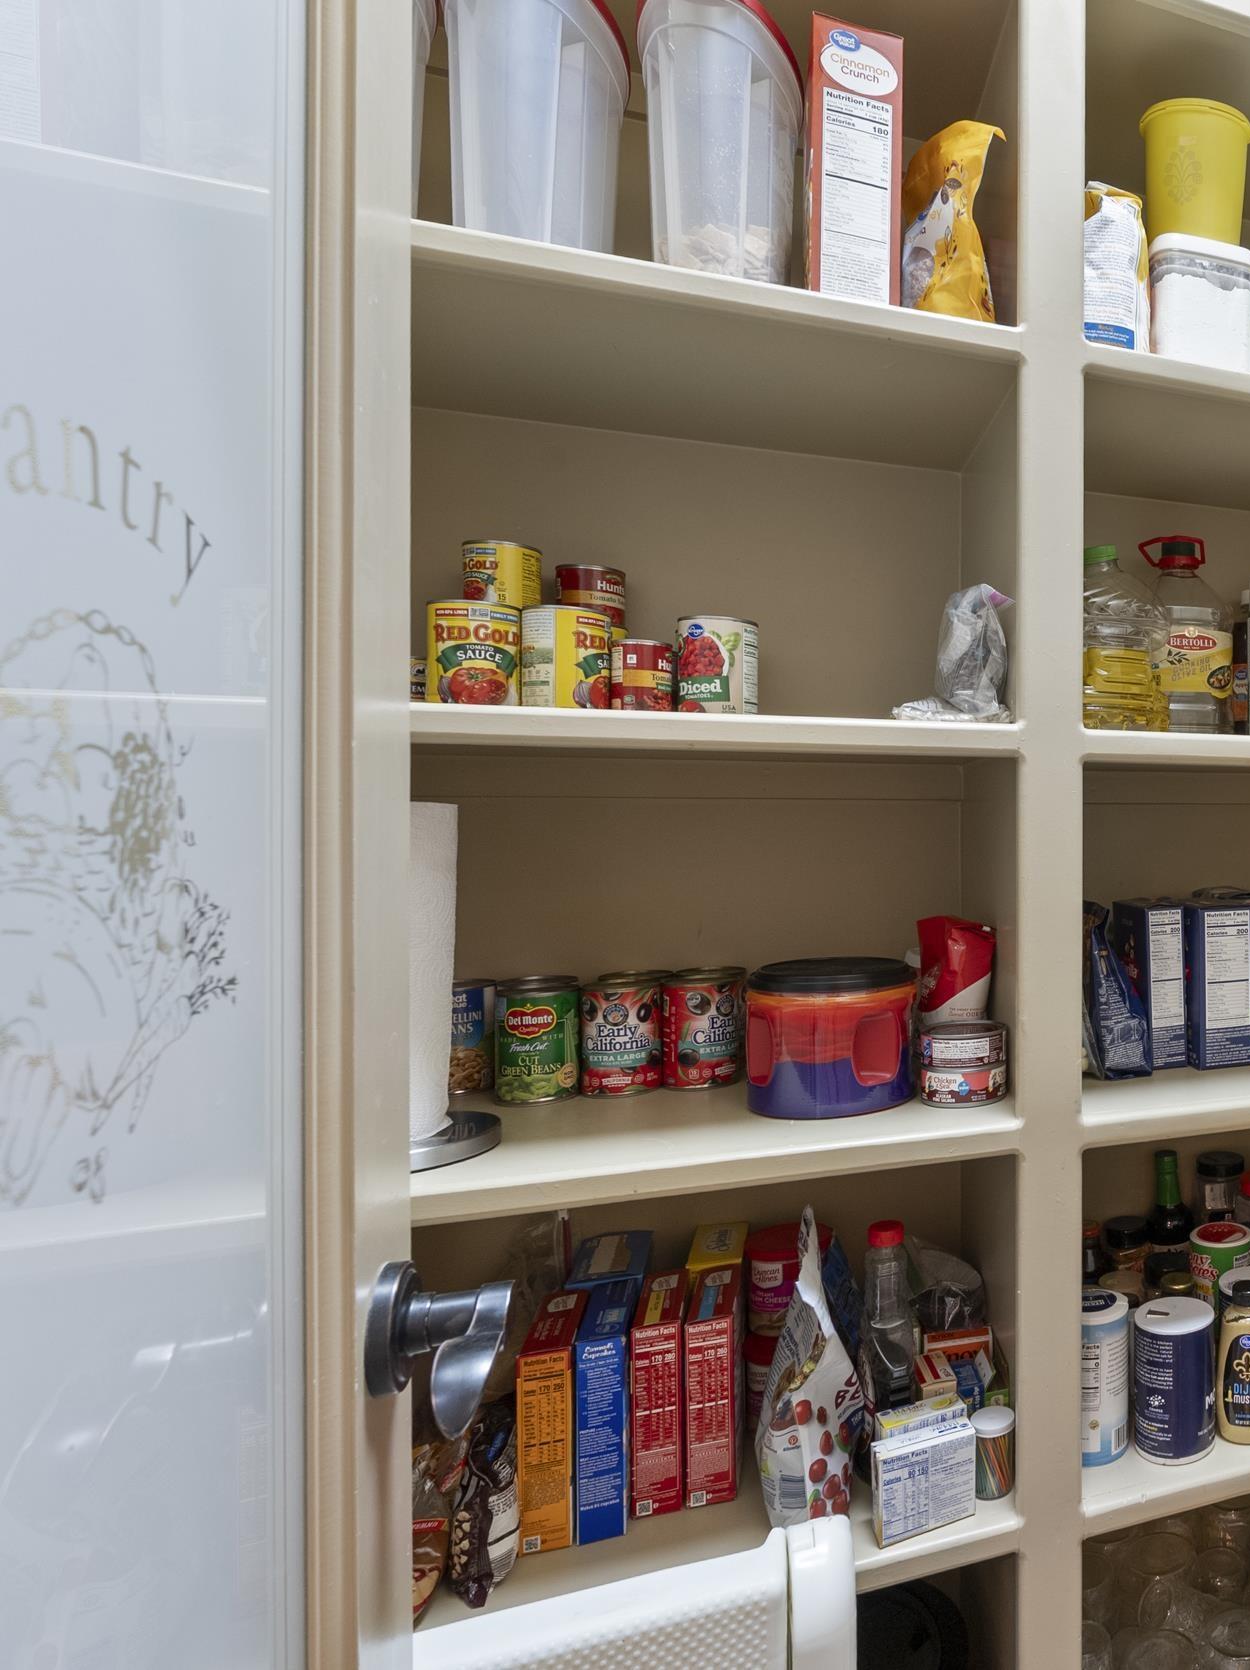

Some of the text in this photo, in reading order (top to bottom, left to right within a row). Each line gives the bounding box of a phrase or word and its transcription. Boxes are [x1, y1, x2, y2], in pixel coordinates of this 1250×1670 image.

[830, 53, 890, 78] Cinnamon
[841, 65, 880, 83] Crunch
[826, 90, 889, 113] Nutrition Facts
[826, 115, 889, 136] Calories 180
[0, 404, 212, 608] antry
[468, 558, 499, 571] GOLD
[434, 623, 520, 646] RED GOLD
[572, 630, 606, 651] RED
[1170, 637, 1213, 647] BERTOLLI
[457, 650, 503, 663] SAUCE
[1200, 664, 1211, 673] OIL
[680, 680, 722, 695] Diced
[508, 1015, 553, 1026] Del Monte
[596, 1023, 639, 1040] Early
[510, 1041, 547, 1053] Fresh Cut
[585, 1034, 650, 1053] California
[519, 1056, 540, 1066] CUT
[589, 1052, 646, 1062] EXTRA LARGE
[501, 1063, 561, 1076] GREEN BEANS
[934, 1076, 957, 1084] Chicken
[754, 1268, 780, 1276] Duncan
[756, 1274, 778, 1282] Hines
[636, 1327, 675, 1339] Nutrition Facts
[689, 1325, 711, 1334] Nutrition
[582, 1350, 616, 1360] Cupcakes
[651, 1354, 662, 1362] 170
[704, 1349, 715, 1357] 170
[523, 1355, 564, 1367] Nutrition Facts
[539, 1382, 564, 1393] 170 250
[883, 1450, 928, 1465] Nutrition Facts
[883, 1477, 901, 1486] Calories
